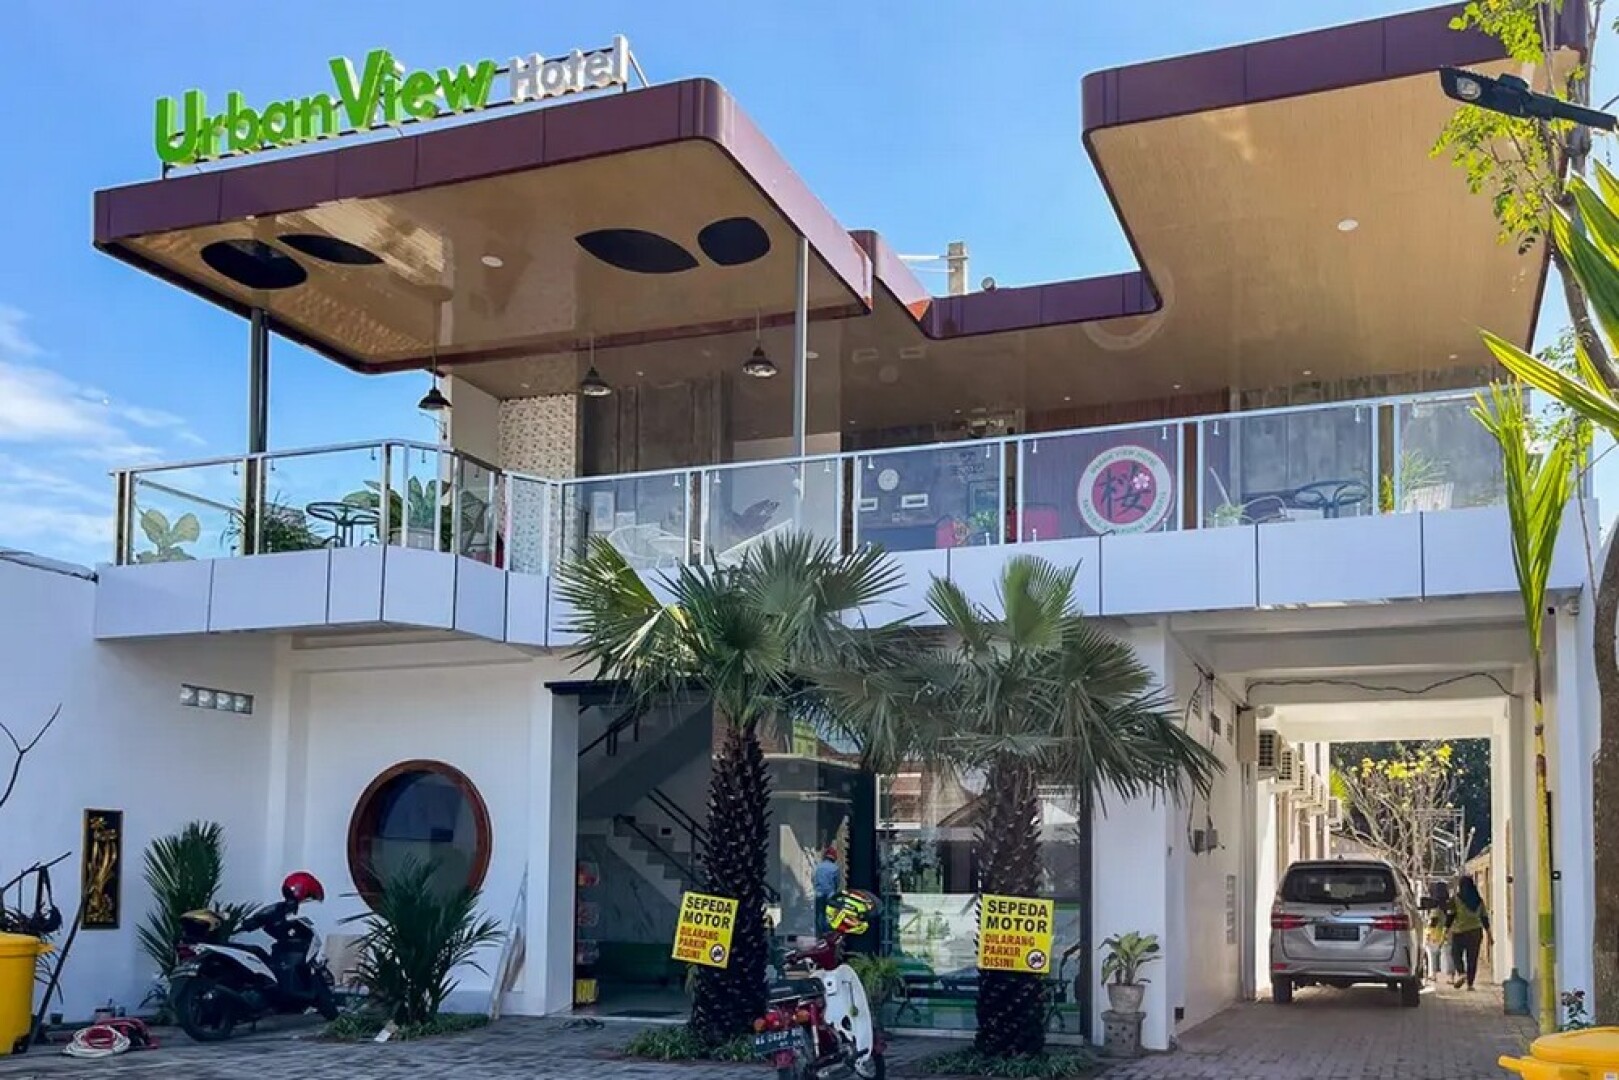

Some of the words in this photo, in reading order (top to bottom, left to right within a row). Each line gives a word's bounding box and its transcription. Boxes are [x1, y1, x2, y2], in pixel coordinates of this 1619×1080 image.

[507, 35, 629, 102] Hotel
[686, 896, 732, 915] SEPEDA
[988, 900, 1048, 918] SEPEDA
[683, 910, 731, 929] MOTOR
[986, 916, 1048, 933] MOTOR
[985, 934, 1036, 947] DILARANG
[984, 945, 1020, 958] PARKIR
[983, 957, 1015, 968] DISINI
